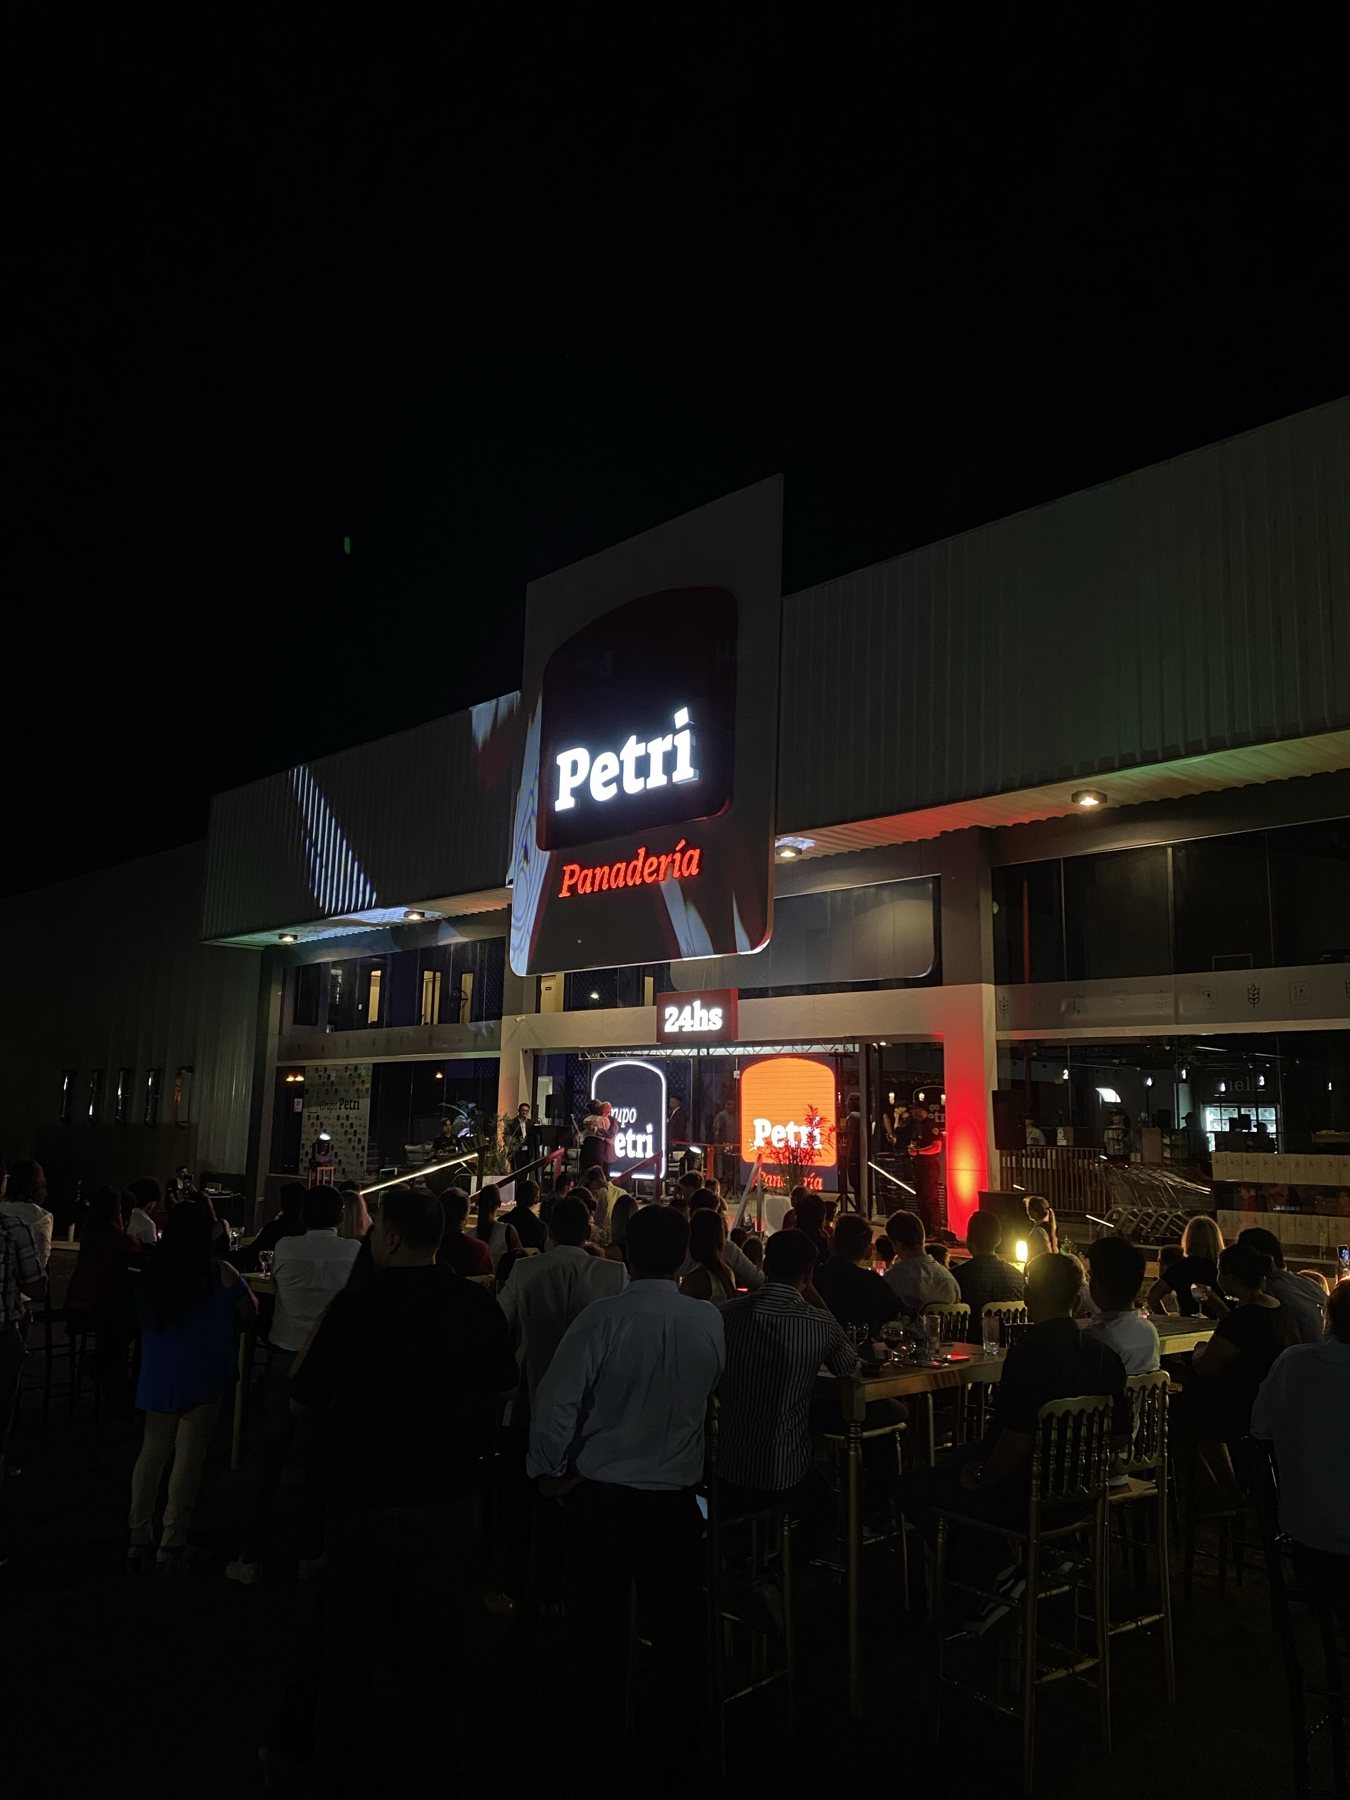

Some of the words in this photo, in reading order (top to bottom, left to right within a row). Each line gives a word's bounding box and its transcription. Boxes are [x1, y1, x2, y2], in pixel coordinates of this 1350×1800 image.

[555, 707, 696, 811] Petri
[559, 838, 700, 898] Panadería
[664, 1000, 722, 1032] 24hs
[339, 1096, 360, 1110] Petri
[611, 1106, 637, 1128] rupo
[614, 1123, 654, 1159] etri
